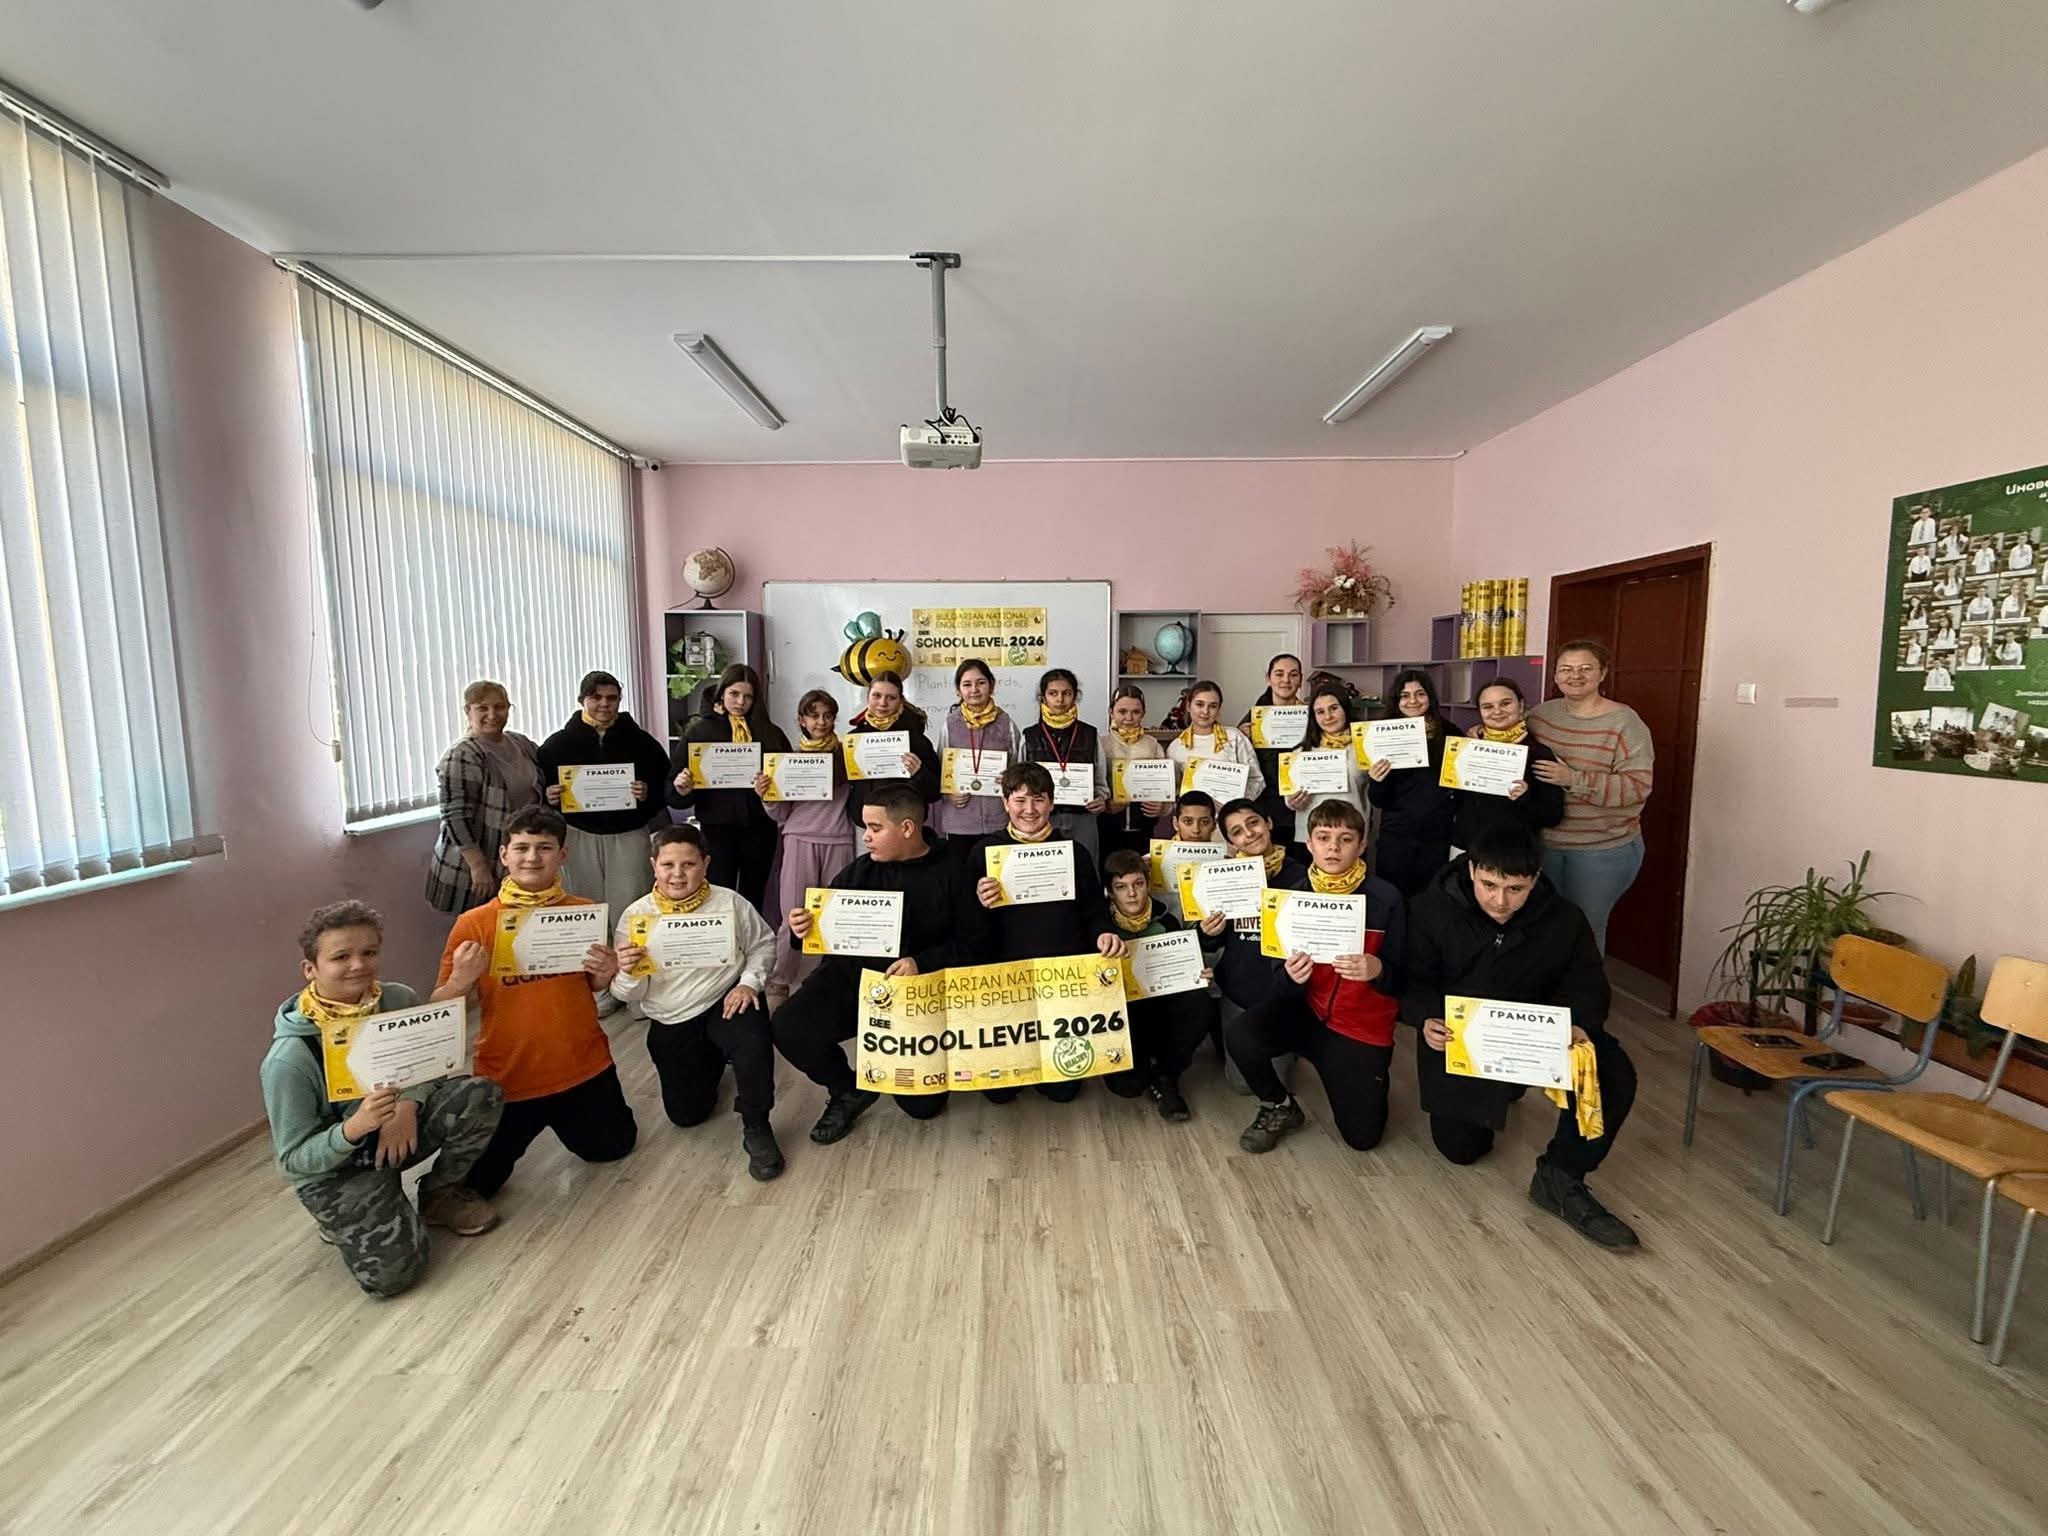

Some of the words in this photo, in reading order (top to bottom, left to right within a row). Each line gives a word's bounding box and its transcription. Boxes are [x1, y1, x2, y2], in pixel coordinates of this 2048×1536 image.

[916, 637, 969, 648] SCHOOL
[972, 637, 1008, 648] LEVEL
[1010, 635, 1045, 647] 2026
[1273, 709, 1308, 717] ГРАМОТА
[1375, 723, 1416, 733] ГРАМОТА
[1473, 744, 1518, 757] ГРАМОТА
[1302, 754, 1340, 762] ГРАМОТА
[586, 769, 626, 777] ГРАМОТА
[1207, 763, 1242, 774] ГРАМОТА
[1017, 849, 1064, 859] ГРАМОТА
[1176, 847, 1219, 855] ГРАМОТА
[1207, 864, 1255, 875] ГРАМОТА
[841, 898, 892, 907] ГРАМОТА
[1297, 900, 1354, 911] ГРАМОТА
[540, 912, 597, 924] ГРАМОТА
[666, 919, 723, 929] ГРАМОТА
[1145, 937, 1189, 951] ГРАМОТА
[906, 974, 1001, 1000] BULGARIAN
[1007, 966, 1087, 986] NATIONAL
[905, 995, 975, 1017] ENGLISH
[981, 985, 1055, 1007] SPELLING
[1060, 982, 1089, 998] BEE
[378, 1009, 451, 1032] ГРАМОТА
[1489, 1009, 1556, 1025] ГРАМОТА
[869, 1017, 891, 1029] BEE
[863, 1029, 973, 1056] SCHOOL
[979, 1019, 1050, 1048] LEVEL
[1053, 1010, 1125, 1038] 2026
